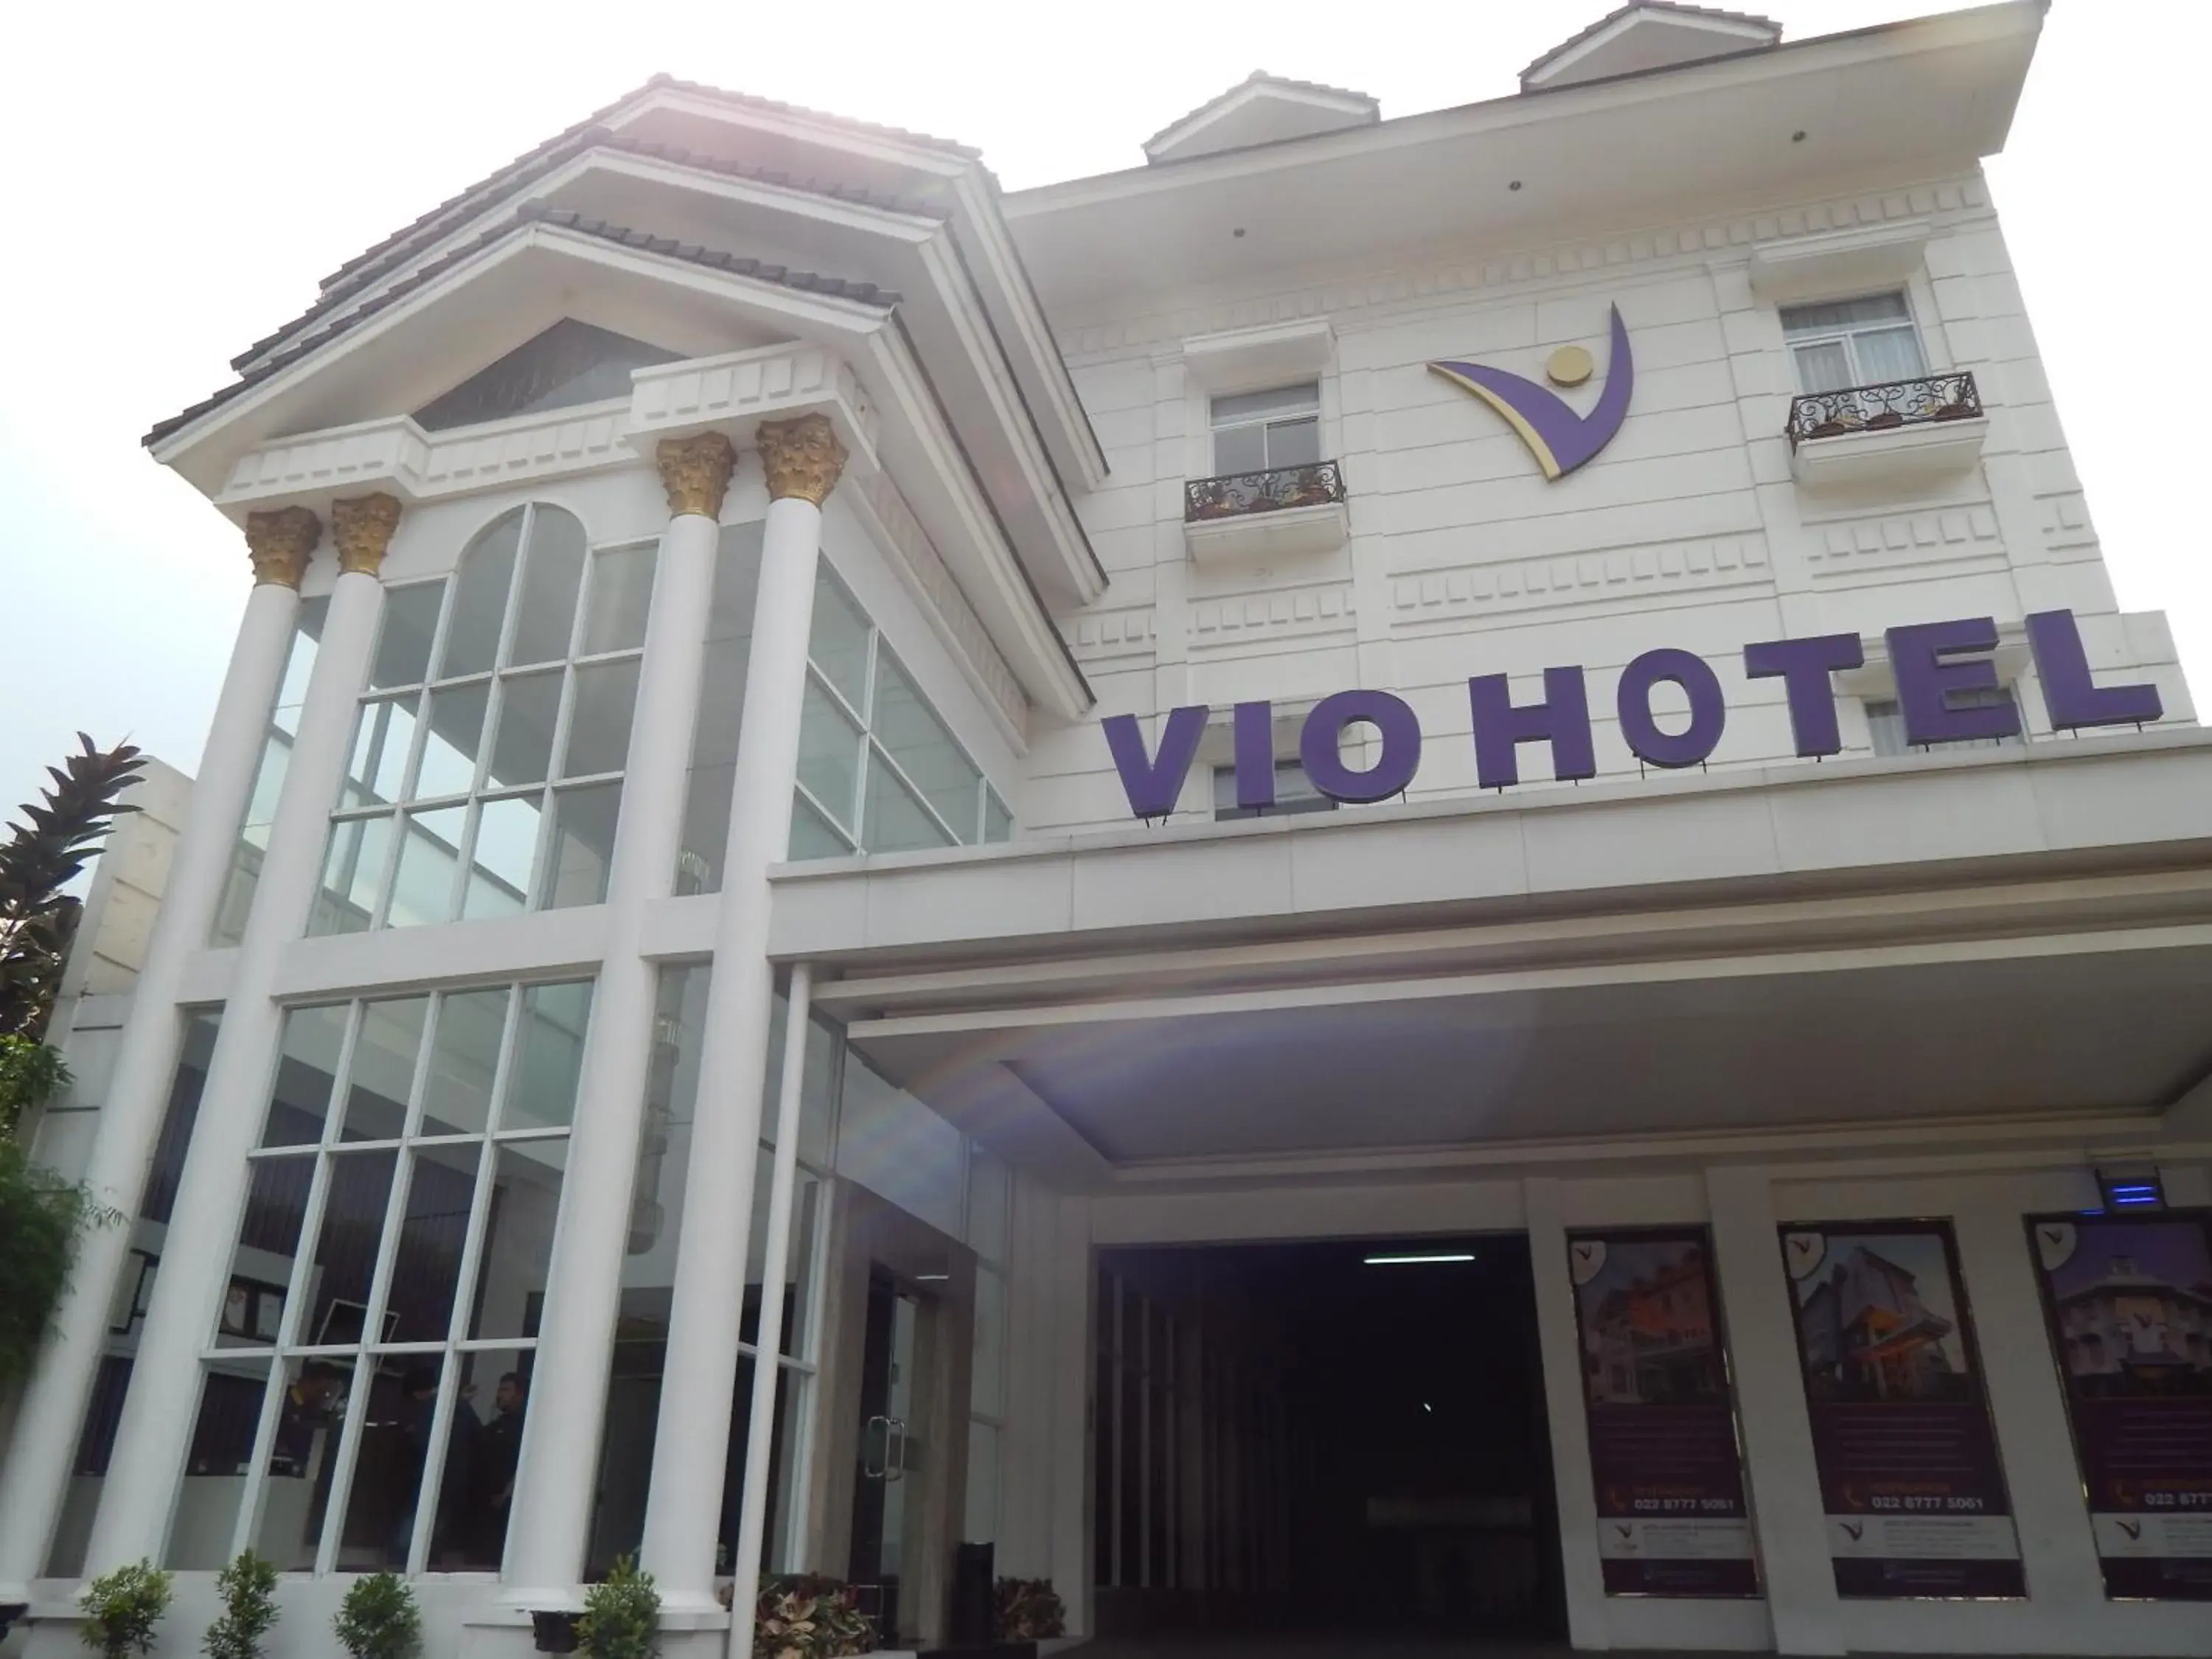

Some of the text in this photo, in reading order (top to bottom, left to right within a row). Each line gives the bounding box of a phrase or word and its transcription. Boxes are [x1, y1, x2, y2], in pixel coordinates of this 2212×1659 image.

[1100, 608, 2163, 820] VIO HOTEL
[1871, 1496, 1902, 1509] 022
[2144, 1492, 2175, 1505] 022
